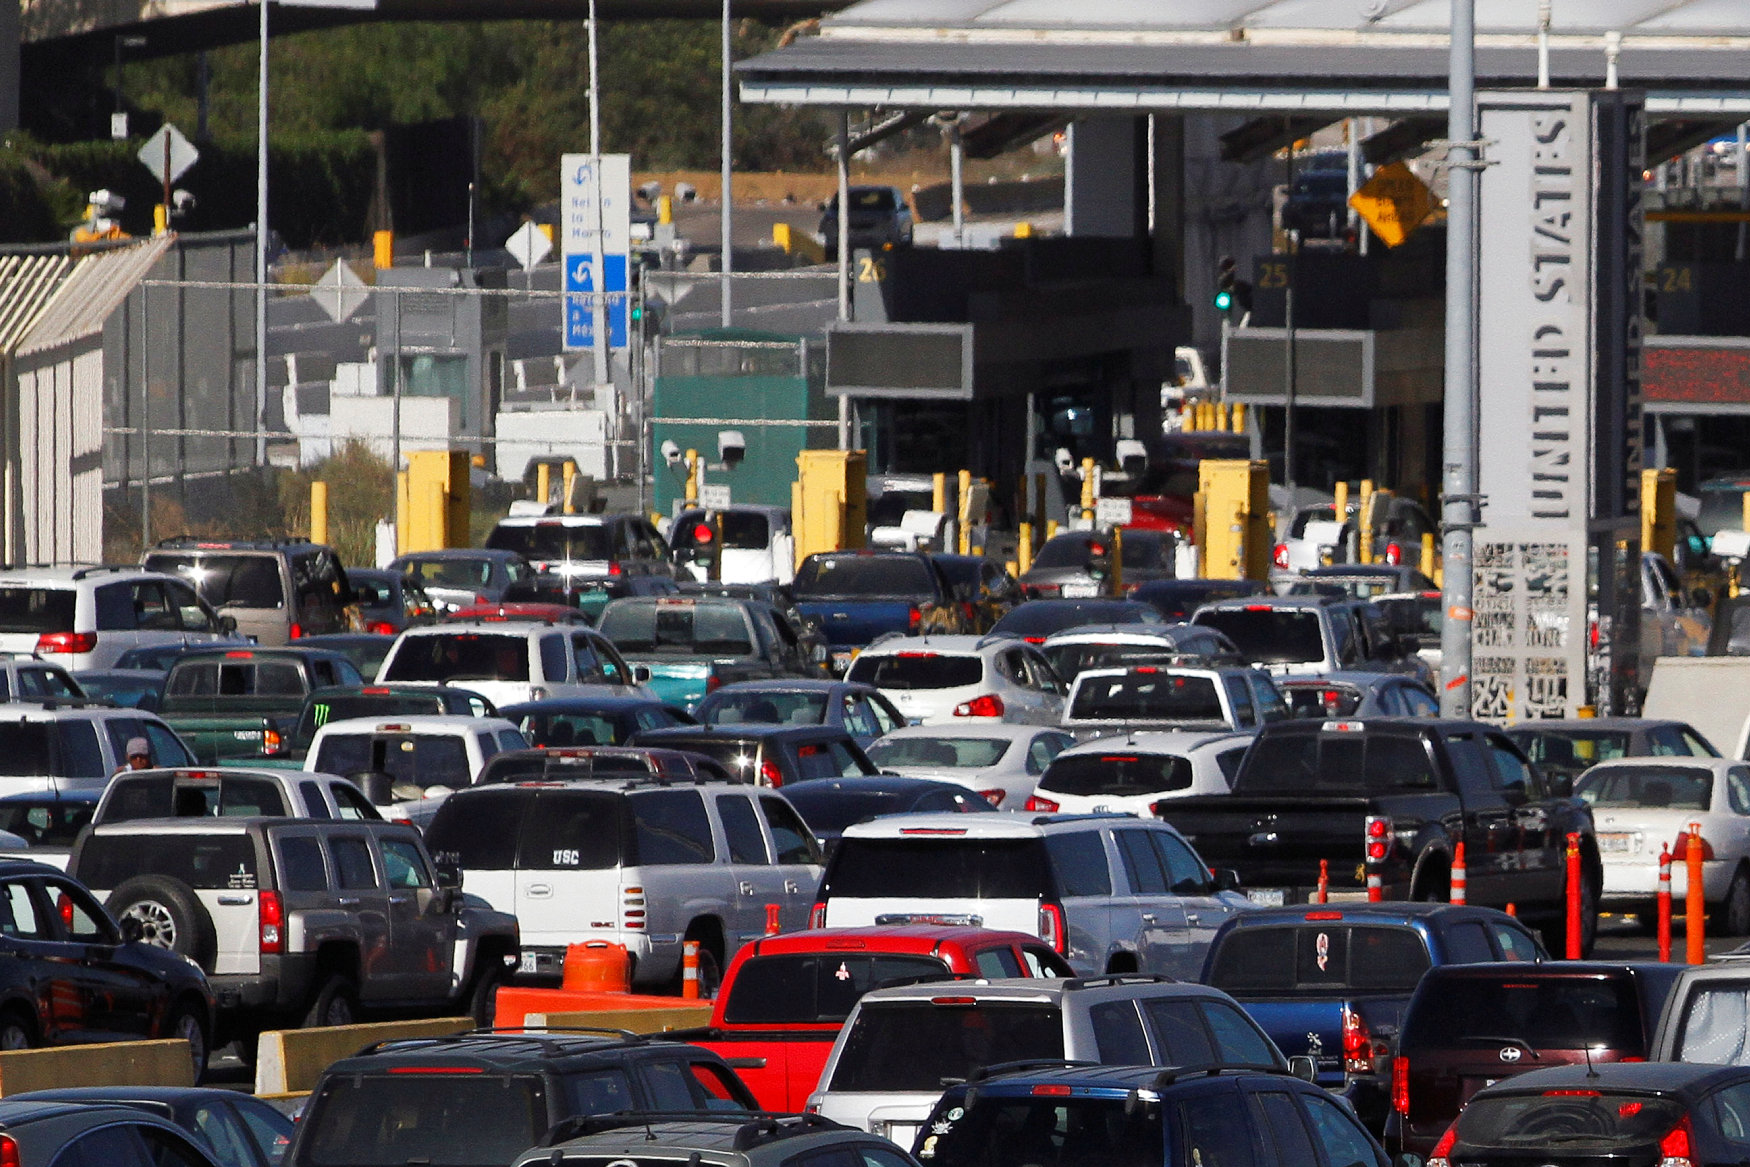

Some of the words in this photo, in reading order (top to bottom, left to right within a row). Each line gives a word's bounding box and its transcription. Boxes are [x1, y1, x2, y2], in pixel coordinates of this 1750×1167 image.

[1533, 117, 1572, 302] STATES
[859, 257, 887, 283] 26
[1259, 264, 1287, 287] 25
[1532, 324, 1570, 519] UNITED
[553, 849, 579, 865] USC
